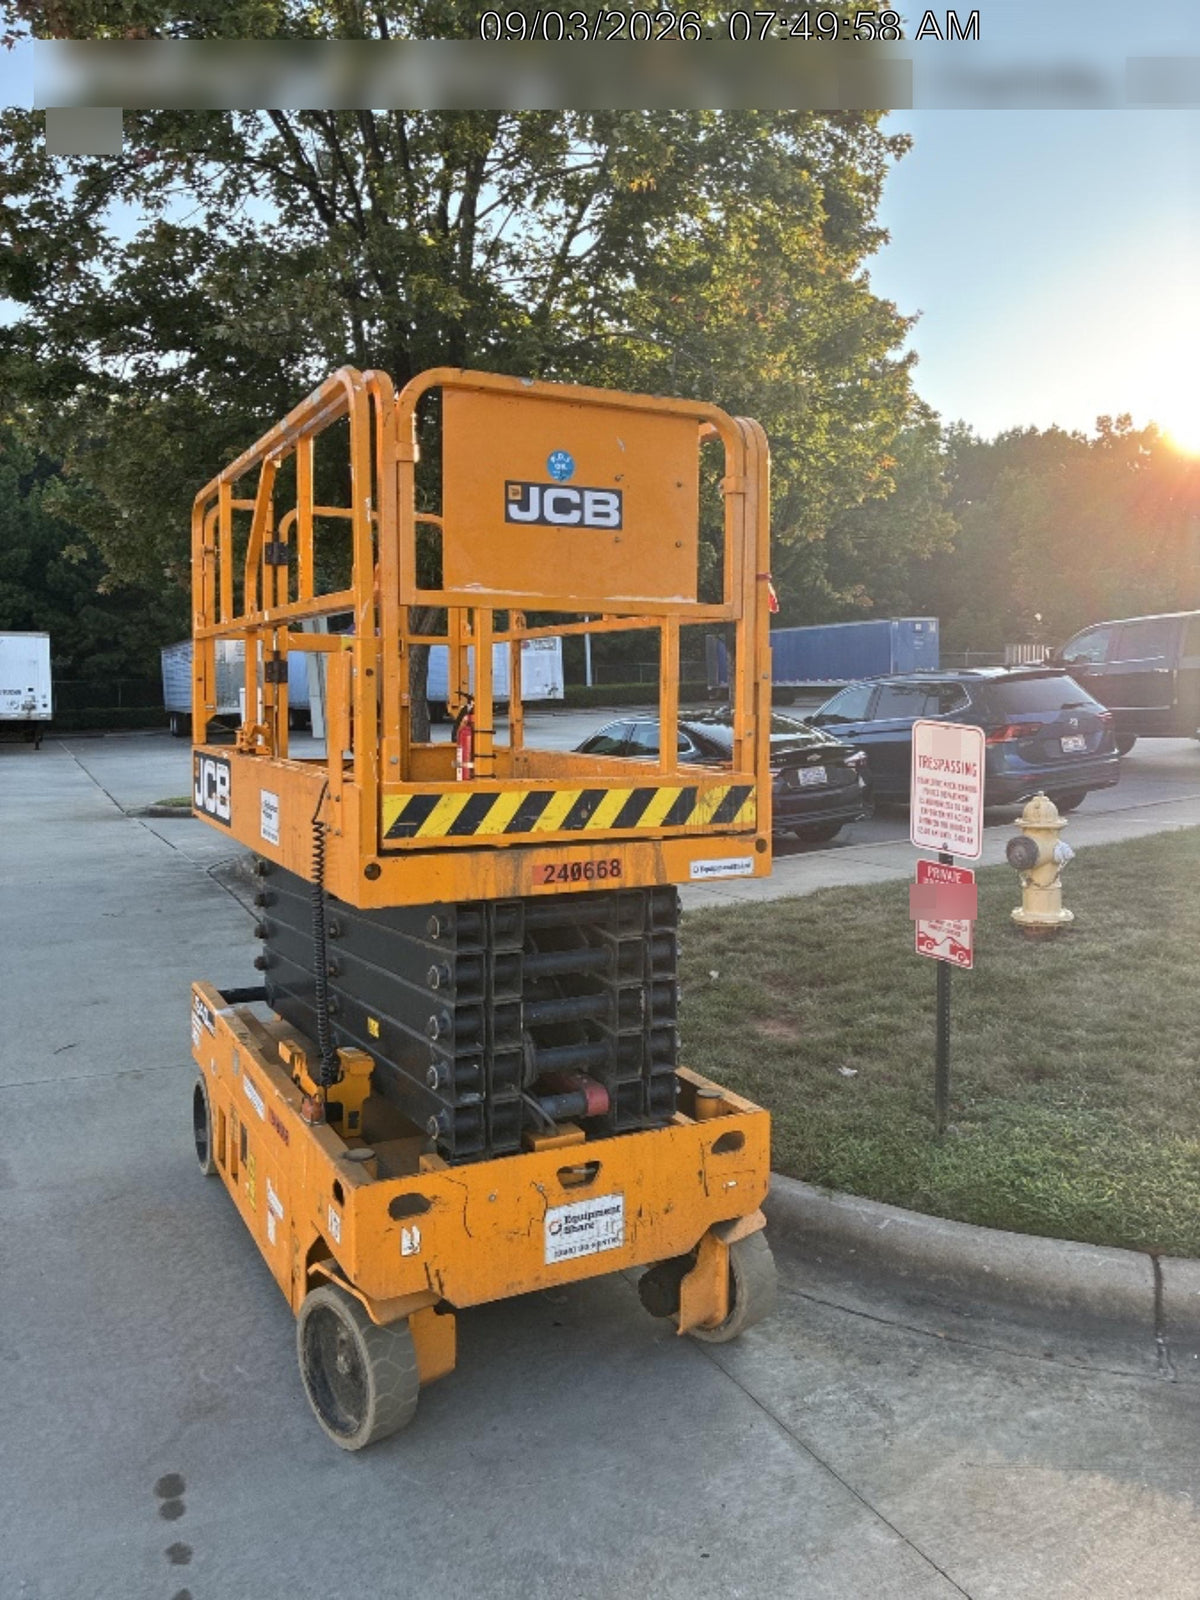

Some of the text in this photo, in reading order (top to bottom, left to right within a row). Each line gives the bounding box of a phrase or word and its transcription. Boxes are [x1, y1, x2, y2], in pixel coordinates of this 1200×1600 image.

[508, 486, 620, 527] JCB
[918, 754, 977, 778] TRESPASSING
[195, 757, 230, 820] JCB
[544, 859, 621, 884] 240668
[927, 865, 962, 884] PRIVATE
[564, 1205, 621, 1224] Equipment
[564, 1221, 594, 1234] Share
